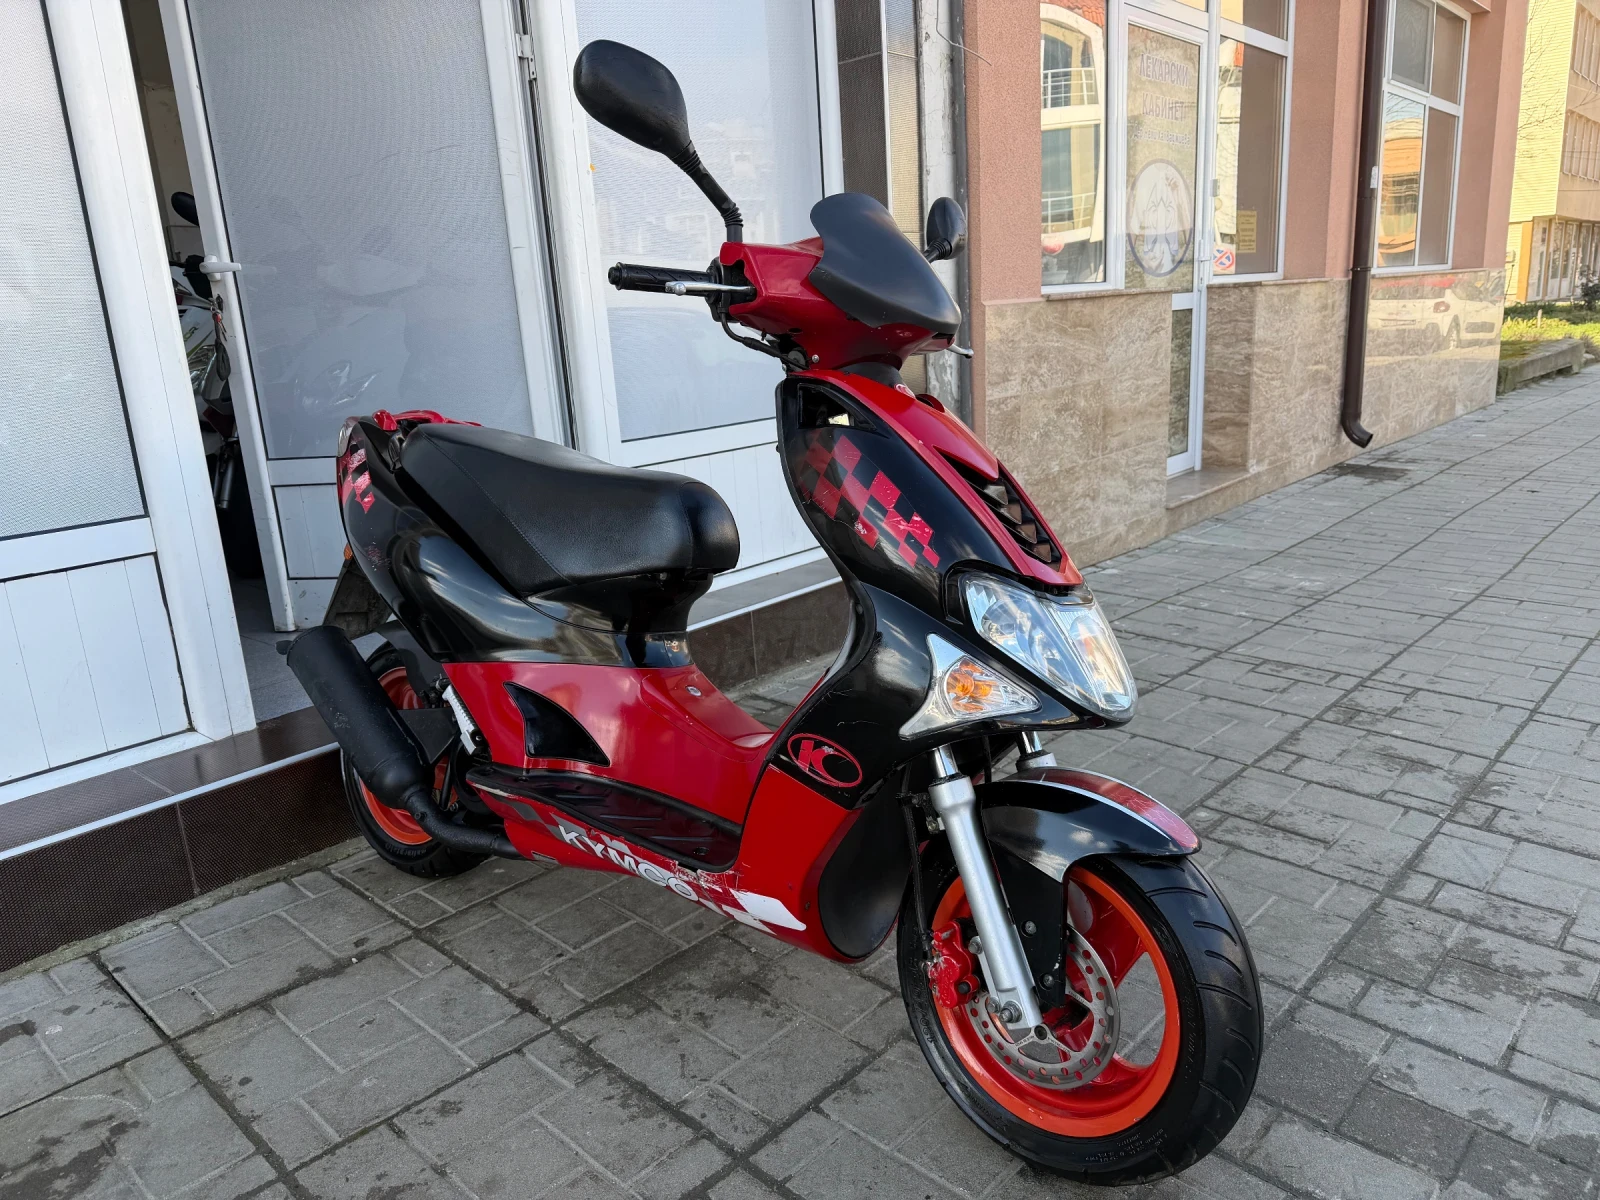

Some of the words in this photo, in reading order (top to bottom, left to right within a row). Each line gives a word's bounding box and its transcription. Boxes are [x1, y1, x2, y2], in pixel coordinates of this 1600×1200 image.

[1139, 53, 1189, 87] ЛЕКАРСКИ
[1142, 92, 1186, 121] КАБИНЕТ
[558, 824, 699, 901] KYMCO
